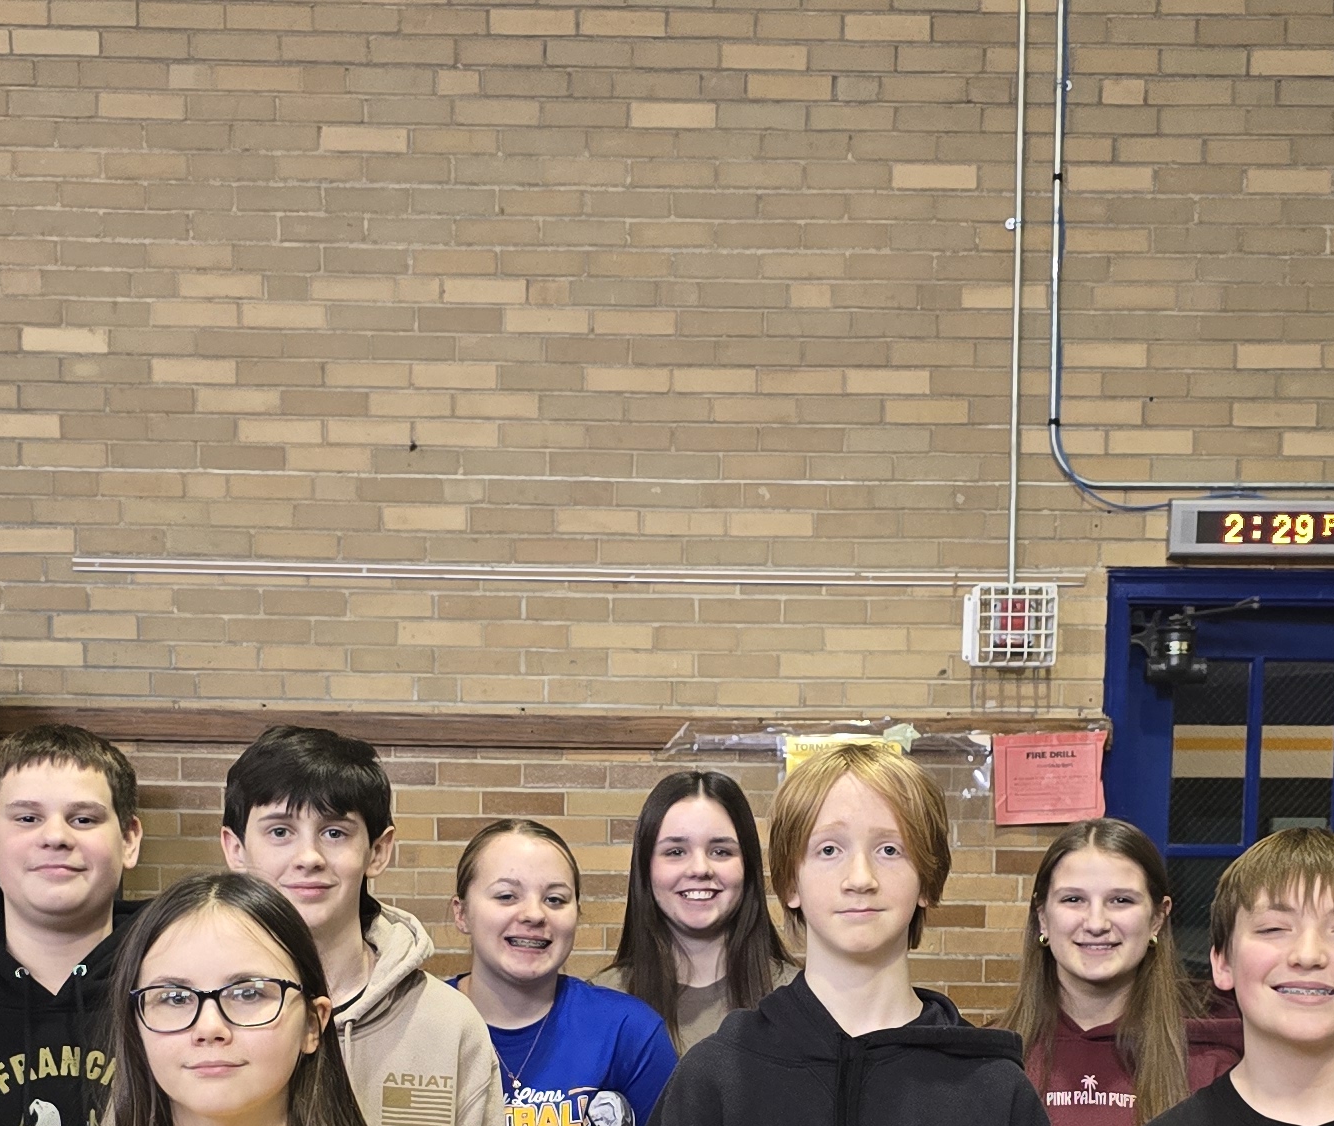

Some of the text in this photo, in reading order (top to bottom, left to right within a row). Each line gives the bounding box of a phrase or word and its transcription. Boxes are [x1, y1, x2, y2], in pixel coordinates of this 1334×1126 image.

[1224, 513, 1315, 544] 2:29
[794, 743, 836, 752] TORNA
[1026, 750, 1077, 760] FIRE DRILL
[383, 1072, 454, 1089] ARIAT
[512, 1087, 566, 1107] Lions
[1047, 1082, 1137, 1109] PINK PALM PUFF
